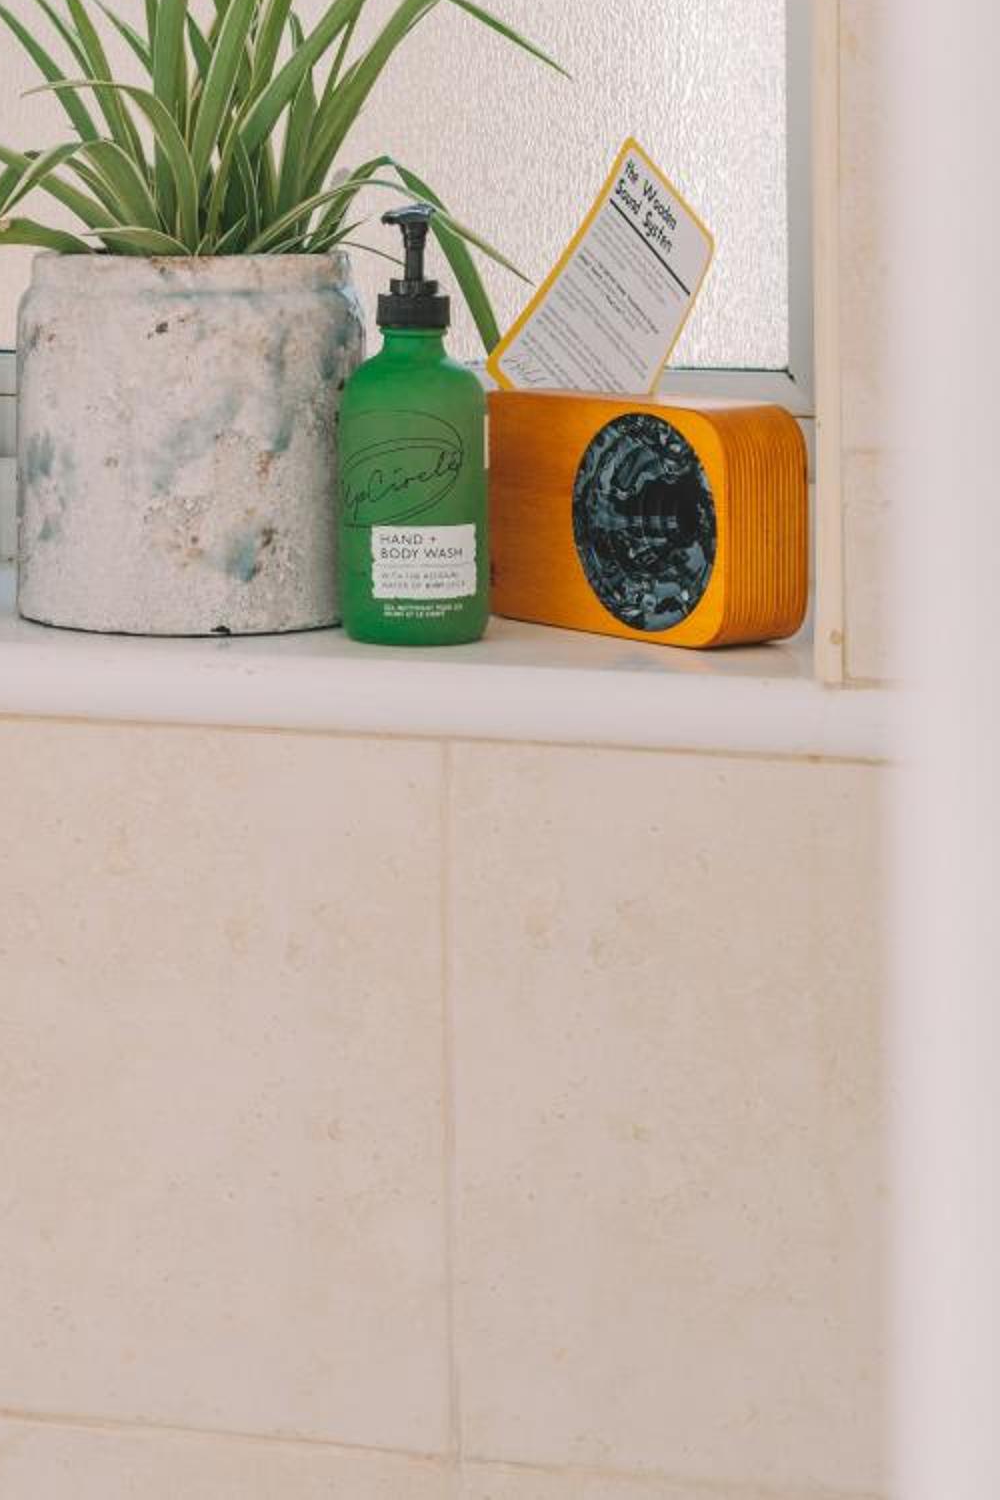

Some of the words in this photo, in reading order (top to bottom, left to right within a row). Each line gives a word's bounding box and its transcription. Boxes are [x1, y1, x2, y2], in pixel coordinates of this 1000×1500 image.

[615, 178, 642, 215] Sound
[643, 211, 673, 253] System
[379, 533, 424, 546] HAND
[380, 547, 419, 560] BODY
[423, 547, 463, 559] WASH
